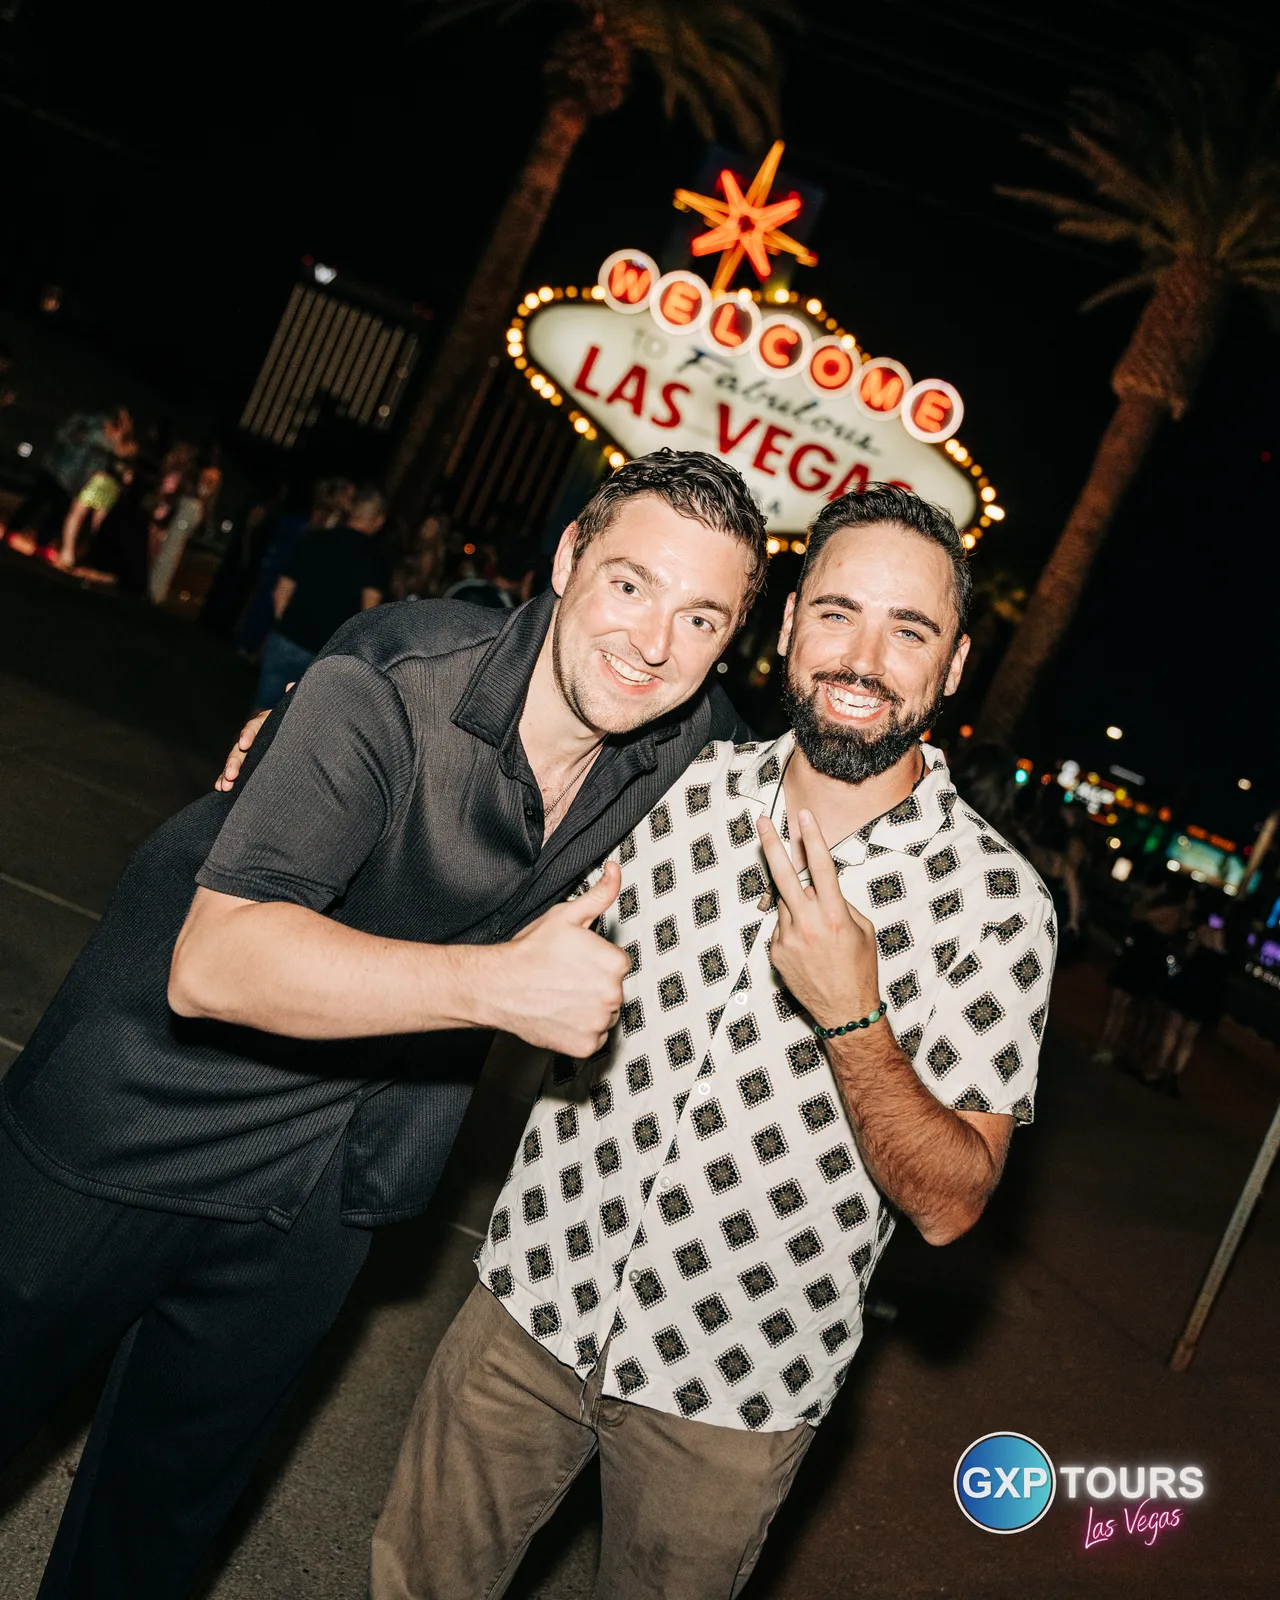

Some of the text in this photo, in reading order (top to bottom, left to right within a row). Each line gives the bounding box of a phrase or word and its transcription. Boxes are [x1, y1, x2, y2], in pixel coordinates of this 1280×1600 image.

[607, 257, 953, 433] WELCOME
[631, 327, 669, 360] TO
[573, 345, 913, 501] LAS VEGA
